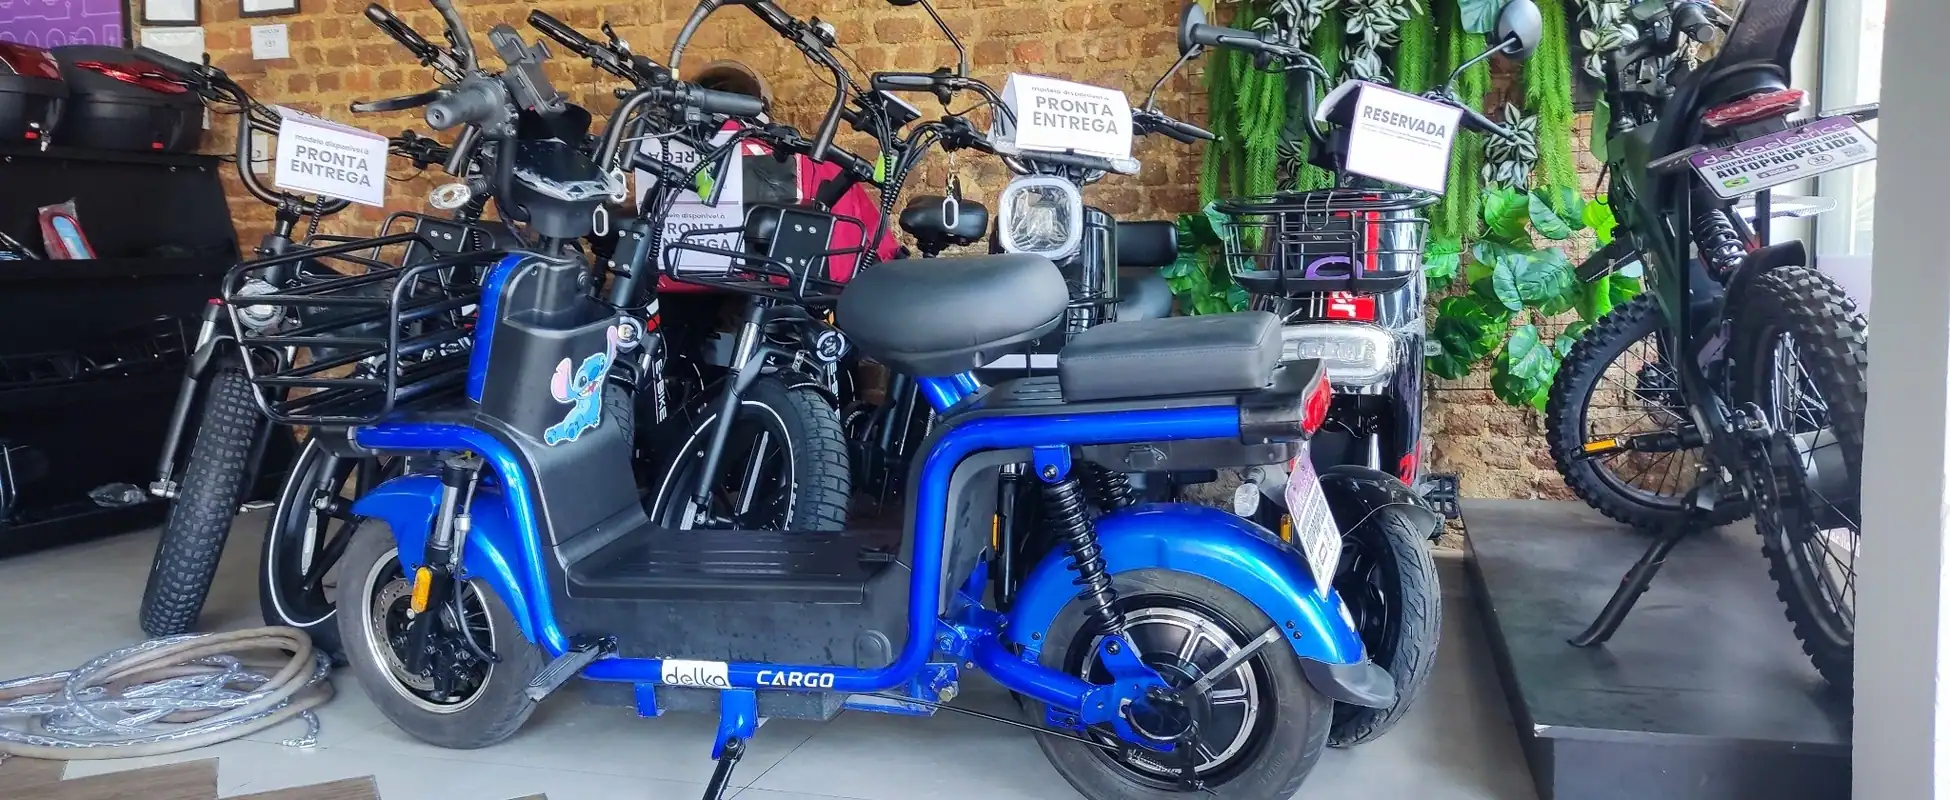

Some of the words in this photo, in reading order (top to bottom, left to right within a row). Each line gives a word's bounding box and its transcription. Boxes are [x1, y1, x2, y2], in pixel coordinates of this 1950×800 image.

[1036, 95, 1114, 117] PRONTA
[1032, 111, 1119, 135] ENTREGA
[1363, 105, 1445, 138] RESERVADA
[294, 133, 324, 147] modelo
[295, 144, 369, 172] PRONTA
[1716, 136, 1859, 179] AUTOPROPELIDO
[290, 158, 372, 188] ENTREGA
[655, 358, 668, 423] E-BIKE
[665, 666, 728, 688] delka
[756, 670, 836, 688] CARGO
